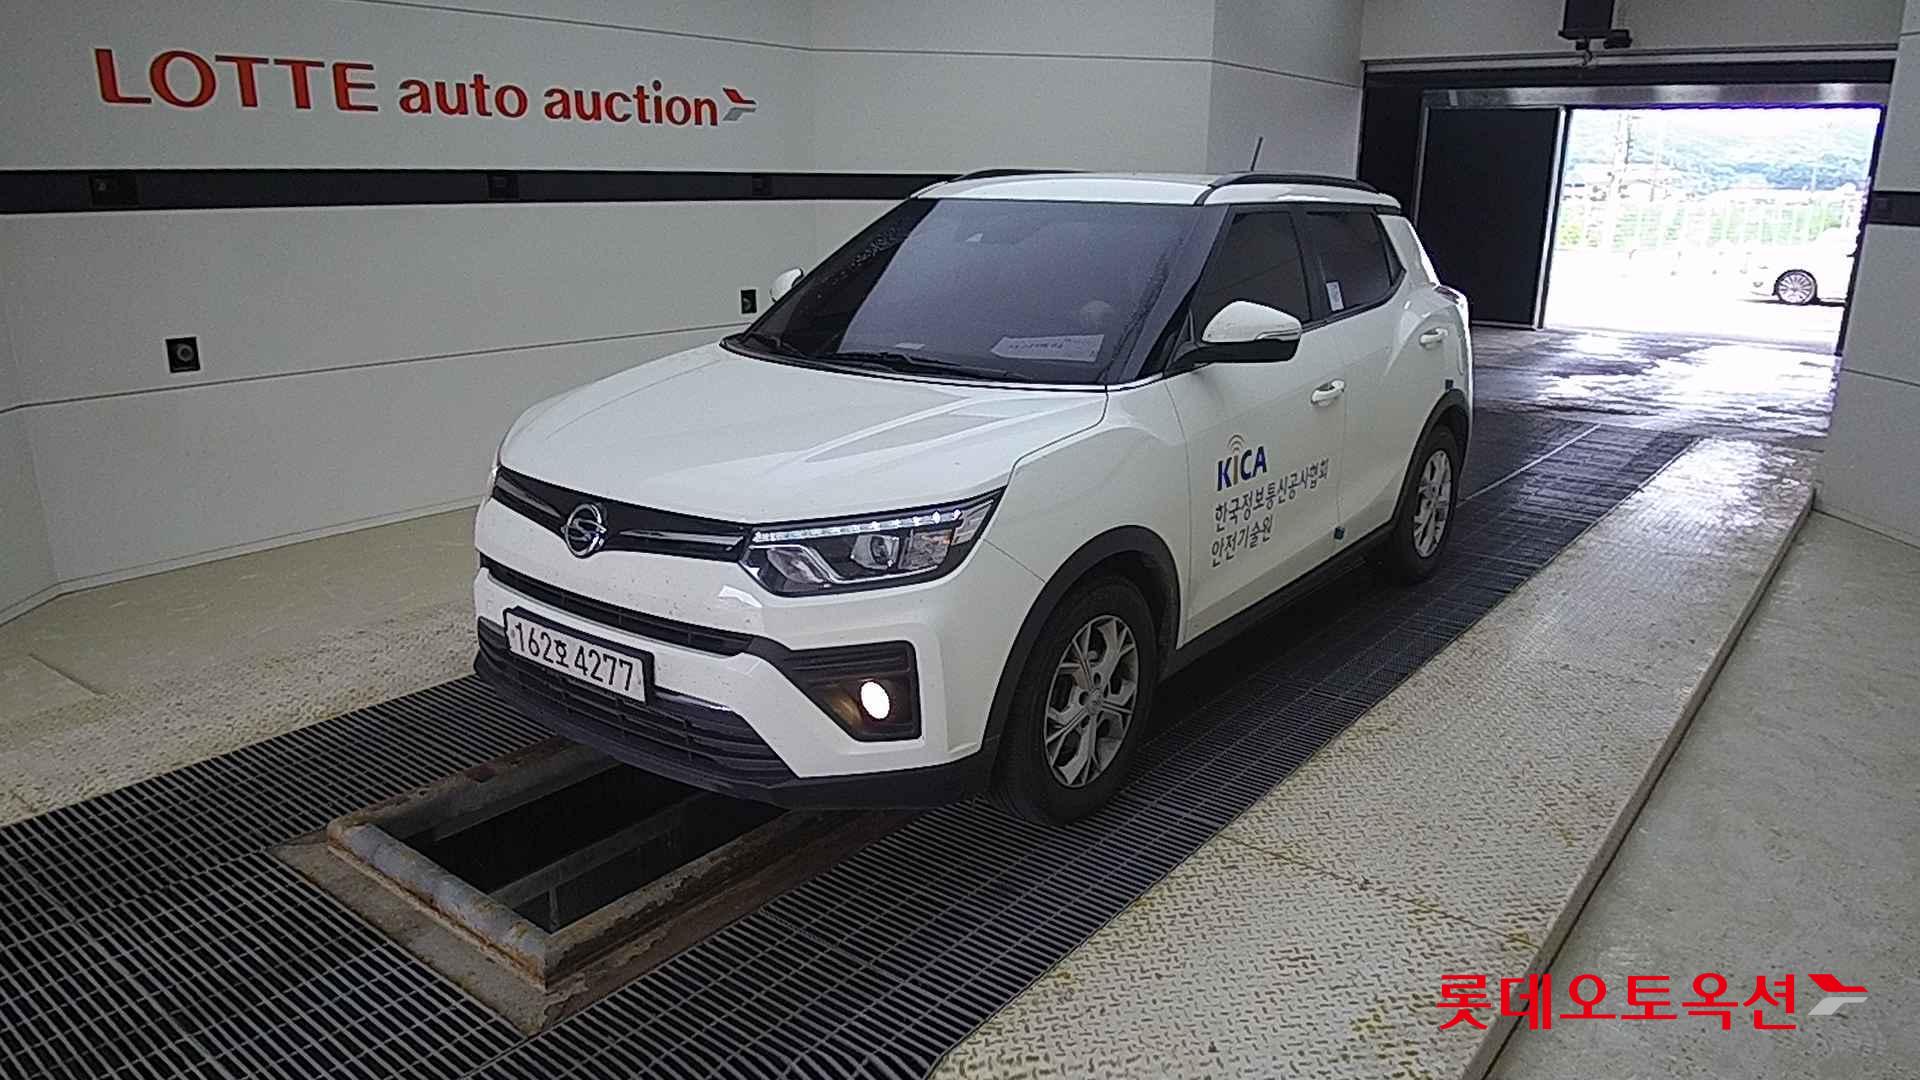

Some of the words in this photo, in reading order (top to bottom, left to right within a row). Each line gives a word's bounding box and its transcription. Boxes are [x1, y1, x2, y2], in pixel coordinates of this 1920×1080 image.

[94, 47, 379, 113] LOTTE
[397, 73, 528, 118] auto
[543, 79, 719, 126] auction
[1215, 457, 1329, 533] 한국정보통신공사협회
[1211, 514, 1273, 568] 안전기술원
[515, 622, 570, 669] 162호
[574, 645, 633, 692] 4277
